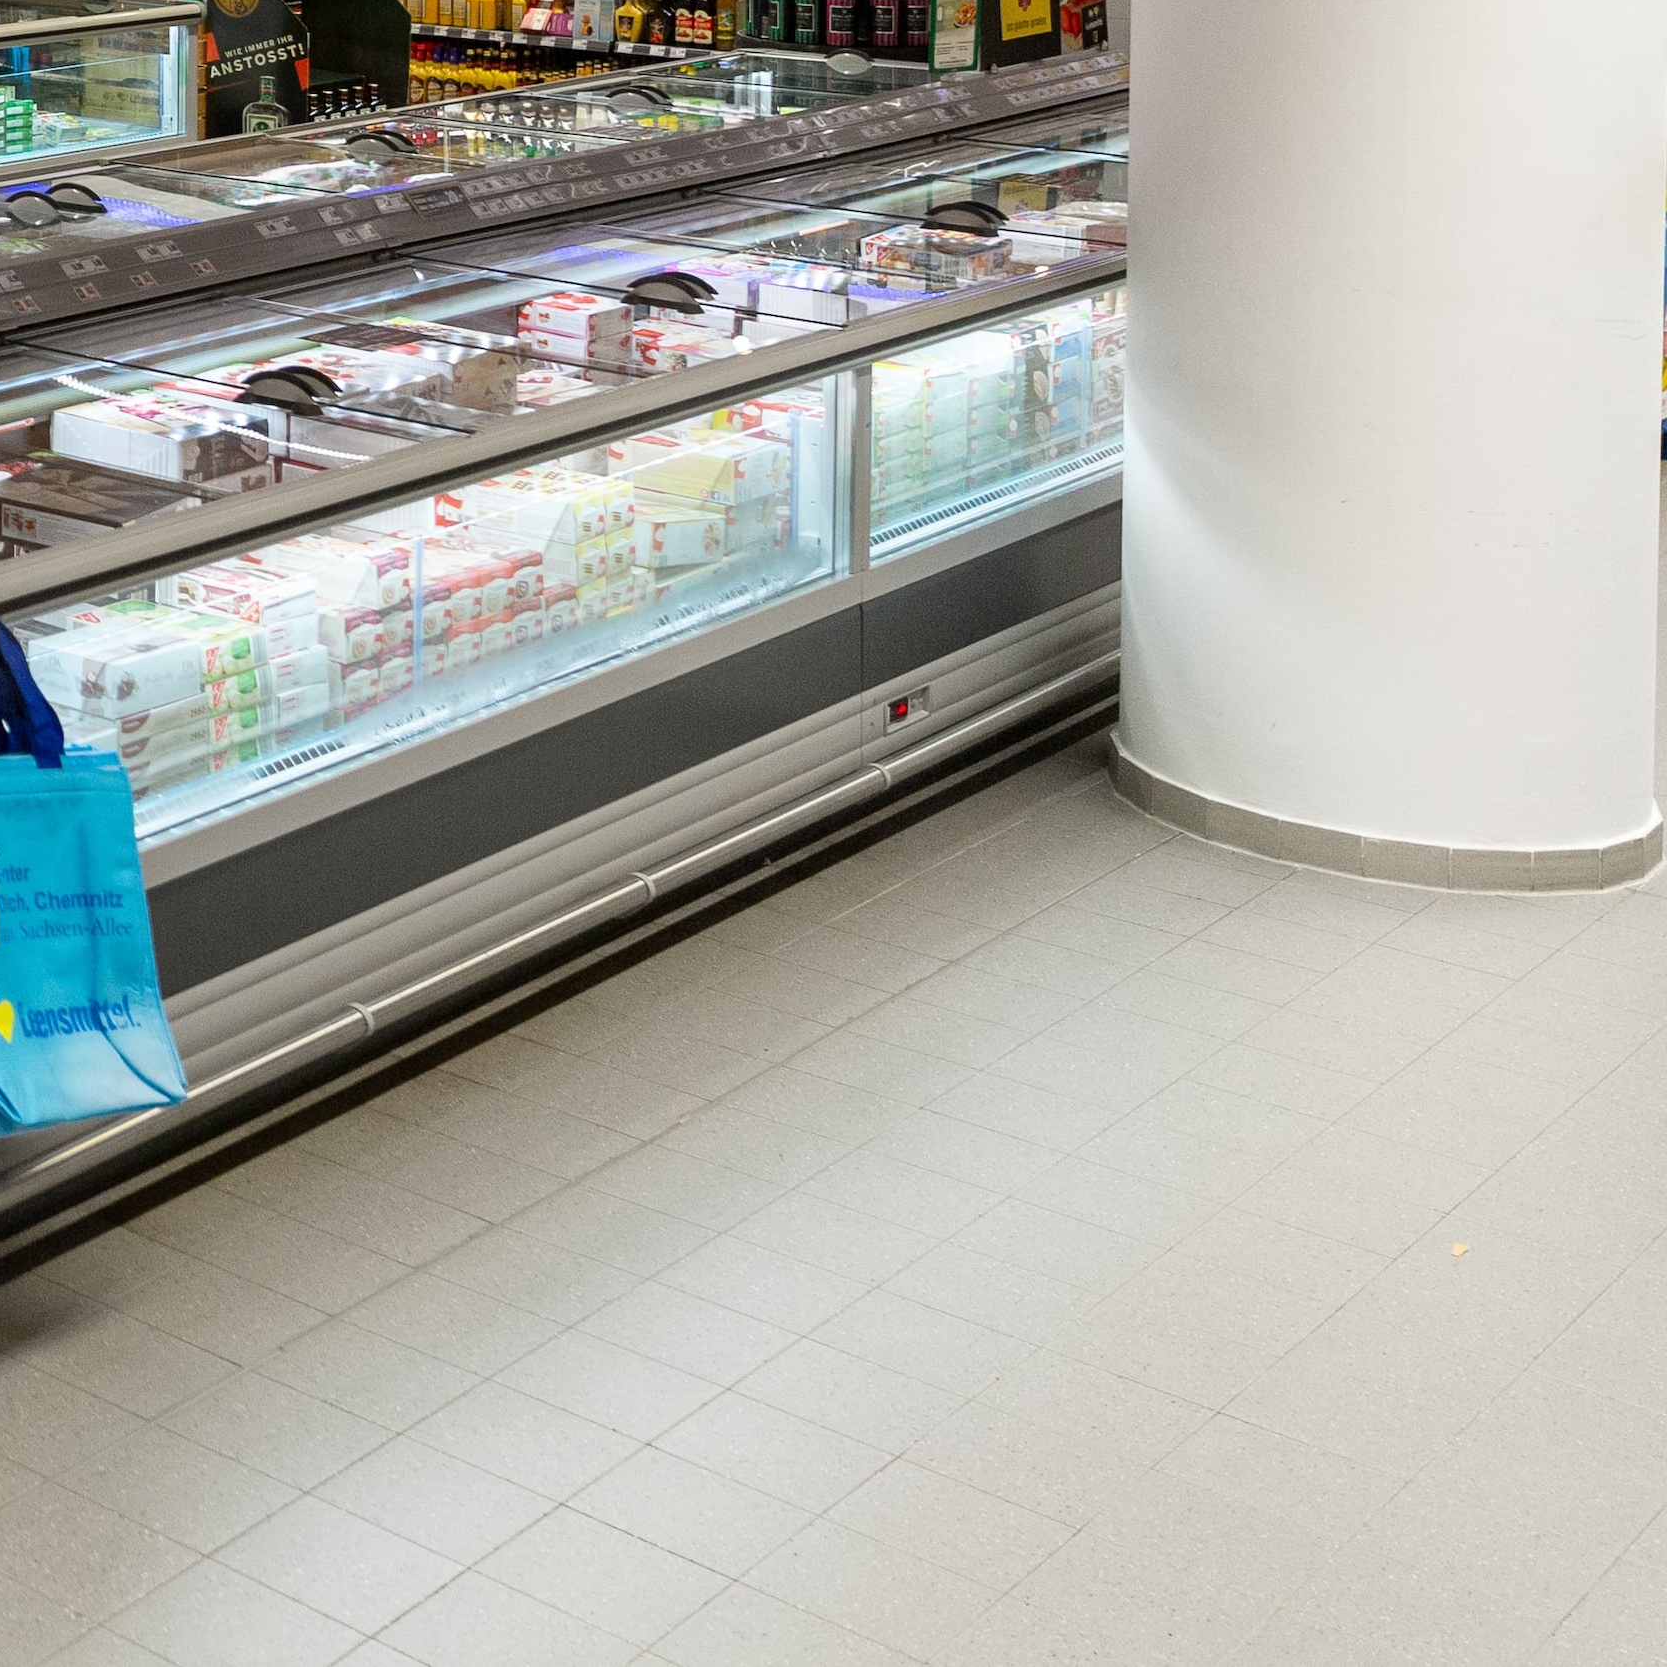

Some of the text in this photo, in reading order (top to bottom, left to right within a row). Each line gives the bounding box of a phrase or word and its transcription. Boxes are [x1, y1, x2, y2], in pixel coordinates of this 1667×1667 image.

[224, 34, 294, 60] WIE IMMER IHR
[209, 43, 305, 79] ANSTOSST!
[34, 889, 123, 910] Chemnitz
